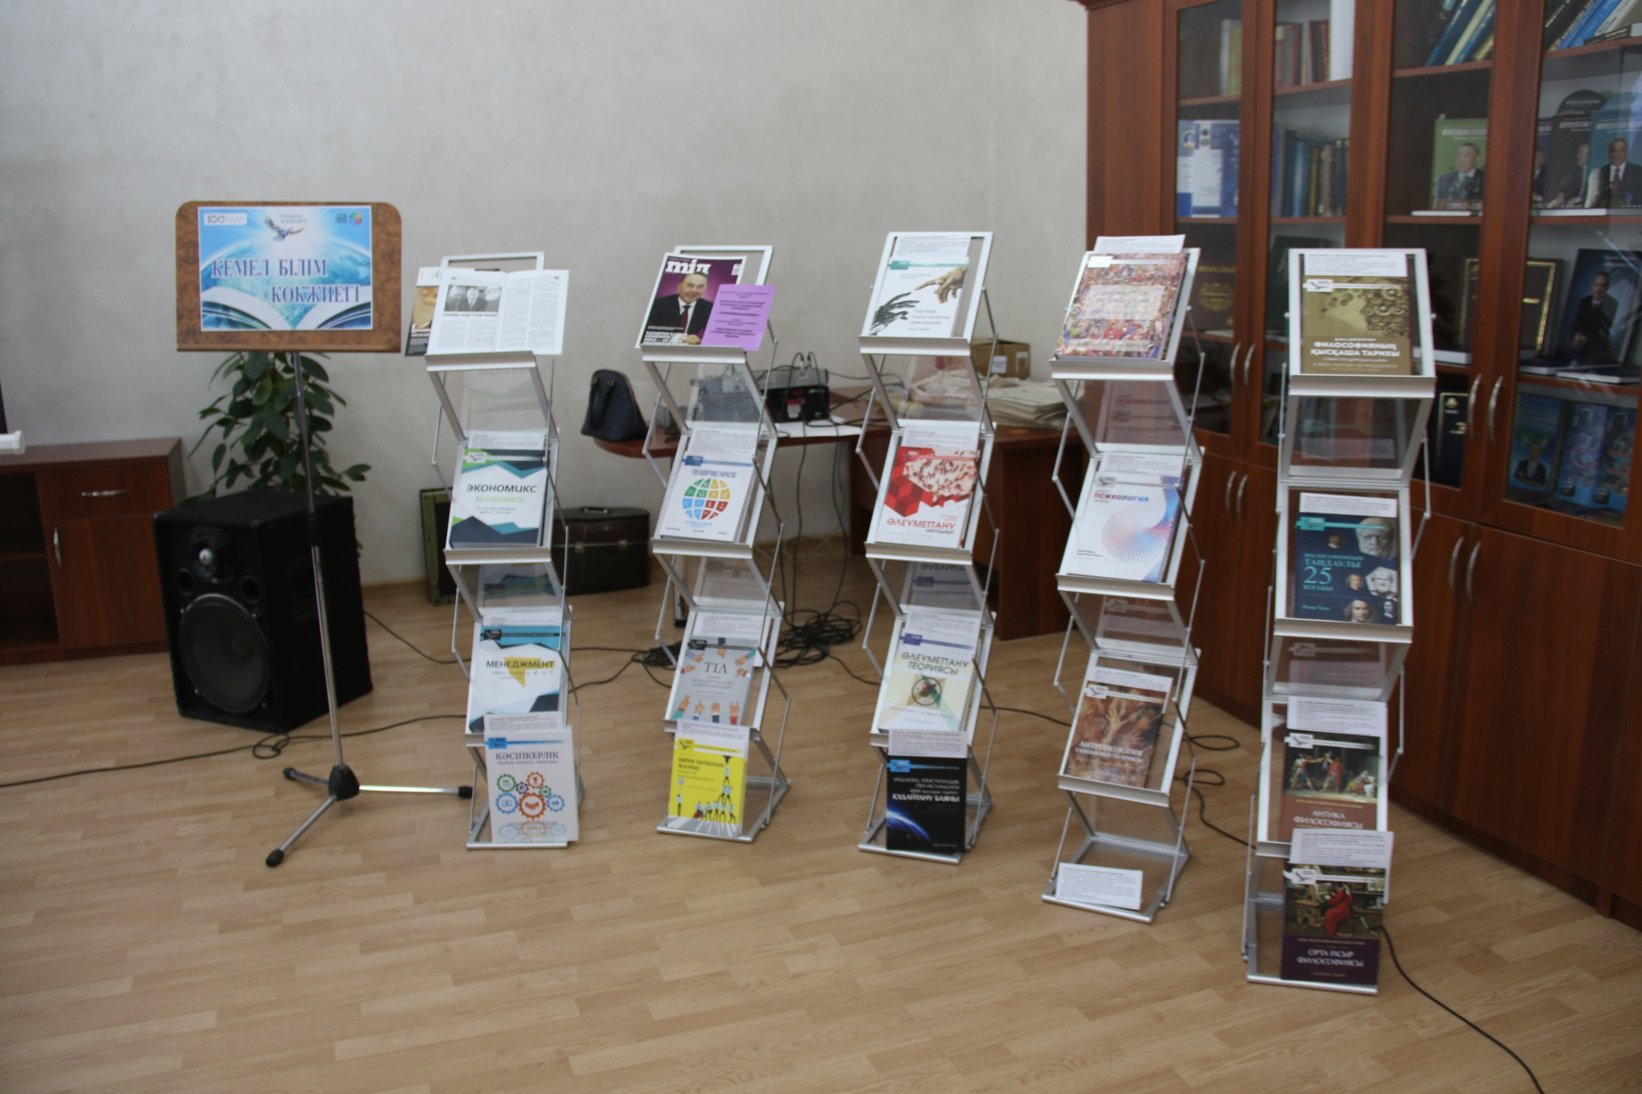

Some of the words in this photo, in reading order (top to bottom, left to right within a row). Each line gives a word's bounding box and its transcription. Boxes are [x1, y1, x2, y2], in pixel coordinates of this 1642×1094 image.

[211, 258, 270, 278] КЕМЕЛ
[279, 259, 327, 277] БІЛІМ
[466, 484, 537, 493] ЭКОНОМИКС
[887, 518, 956, 530] ӘЛЕУМЕТТАНУ
[1304, 566, 1332, 584] 25
[486, 660, 555, 668] МЕНЕДЖМЕНТ
[901, 652, 969, 668] ӘЛЕУМЕТТАНУ
[908, 661, 960, 676] ТЕОРИЯСЫ
[495, 751, 559, 760] КӘСІПКЕРЛІК
